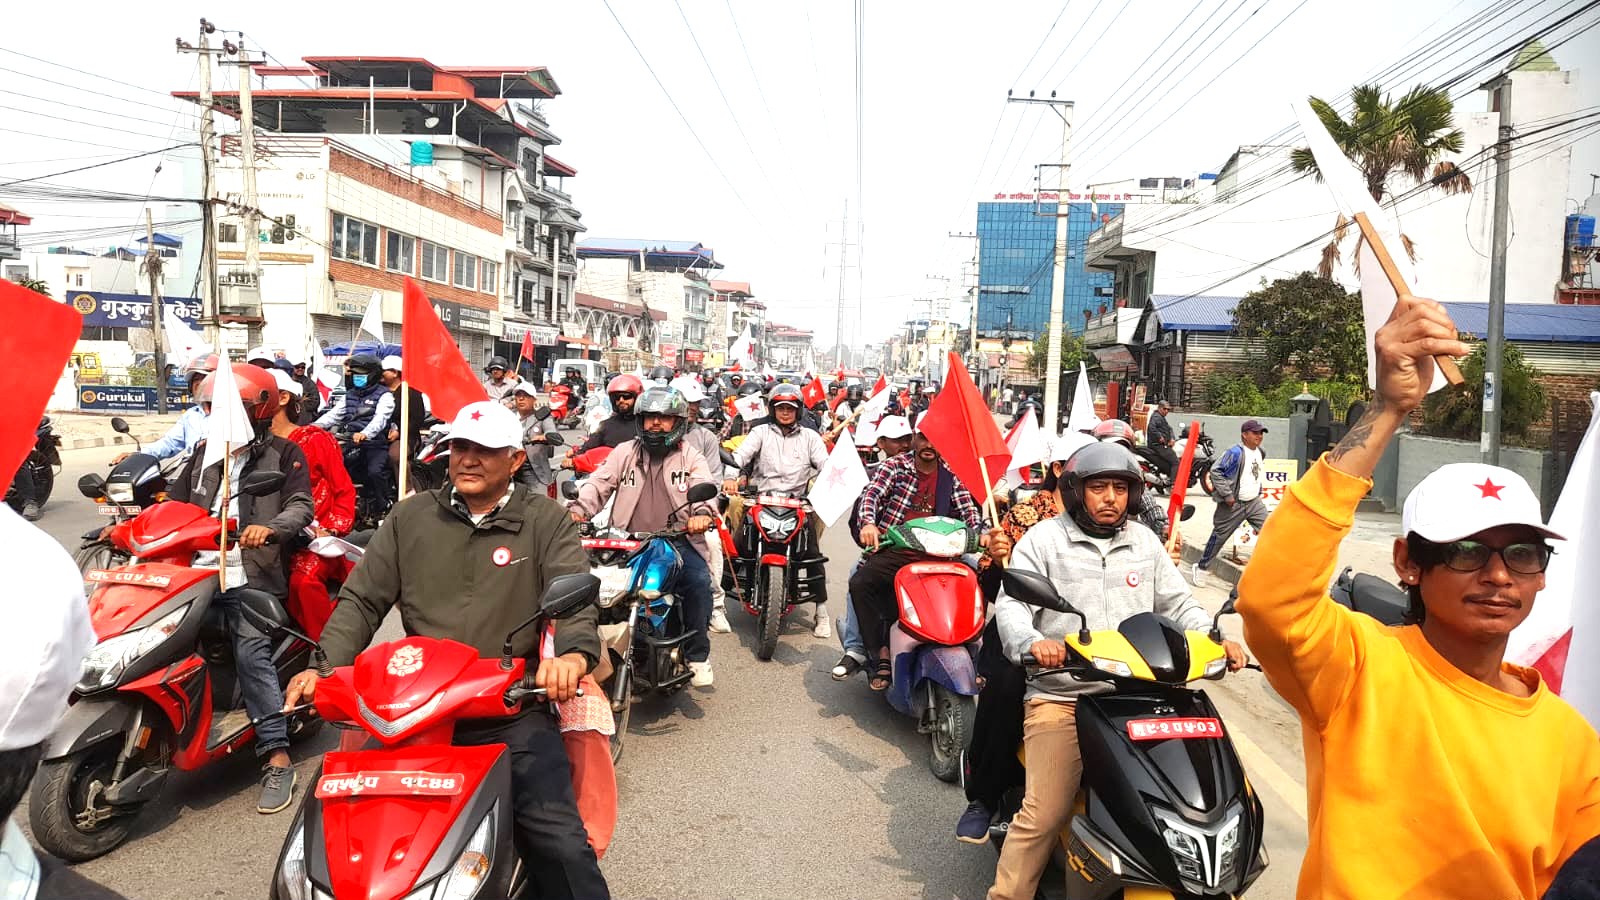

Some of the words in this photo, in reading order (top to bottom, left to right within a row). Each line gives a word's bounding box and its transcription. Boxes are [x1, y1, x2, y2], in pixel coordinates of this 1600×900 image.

[441, 307, 452, 322] LG
[96, 391, 146, 402] Gurukul
[375, 702, 412, 711] HONDA
